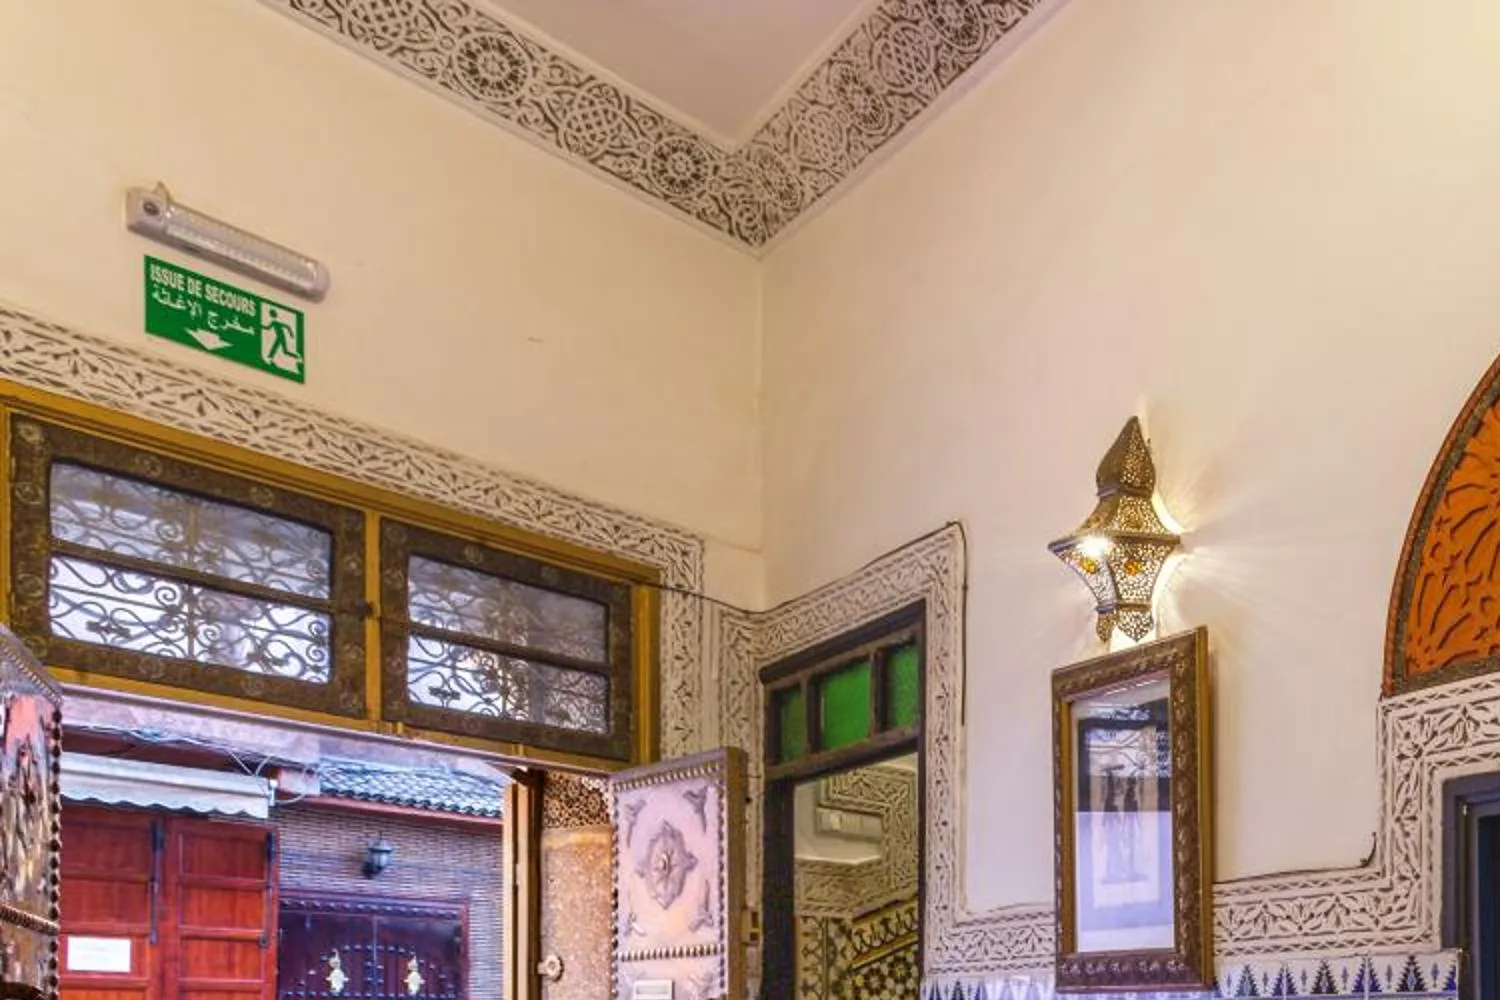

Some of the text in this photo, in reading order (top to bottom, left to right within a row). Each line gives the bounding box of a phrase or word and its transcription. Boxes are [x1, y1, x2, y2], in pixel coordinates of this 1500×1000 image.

[150, 263, 257, 317] ISSUE DE SECOURS
